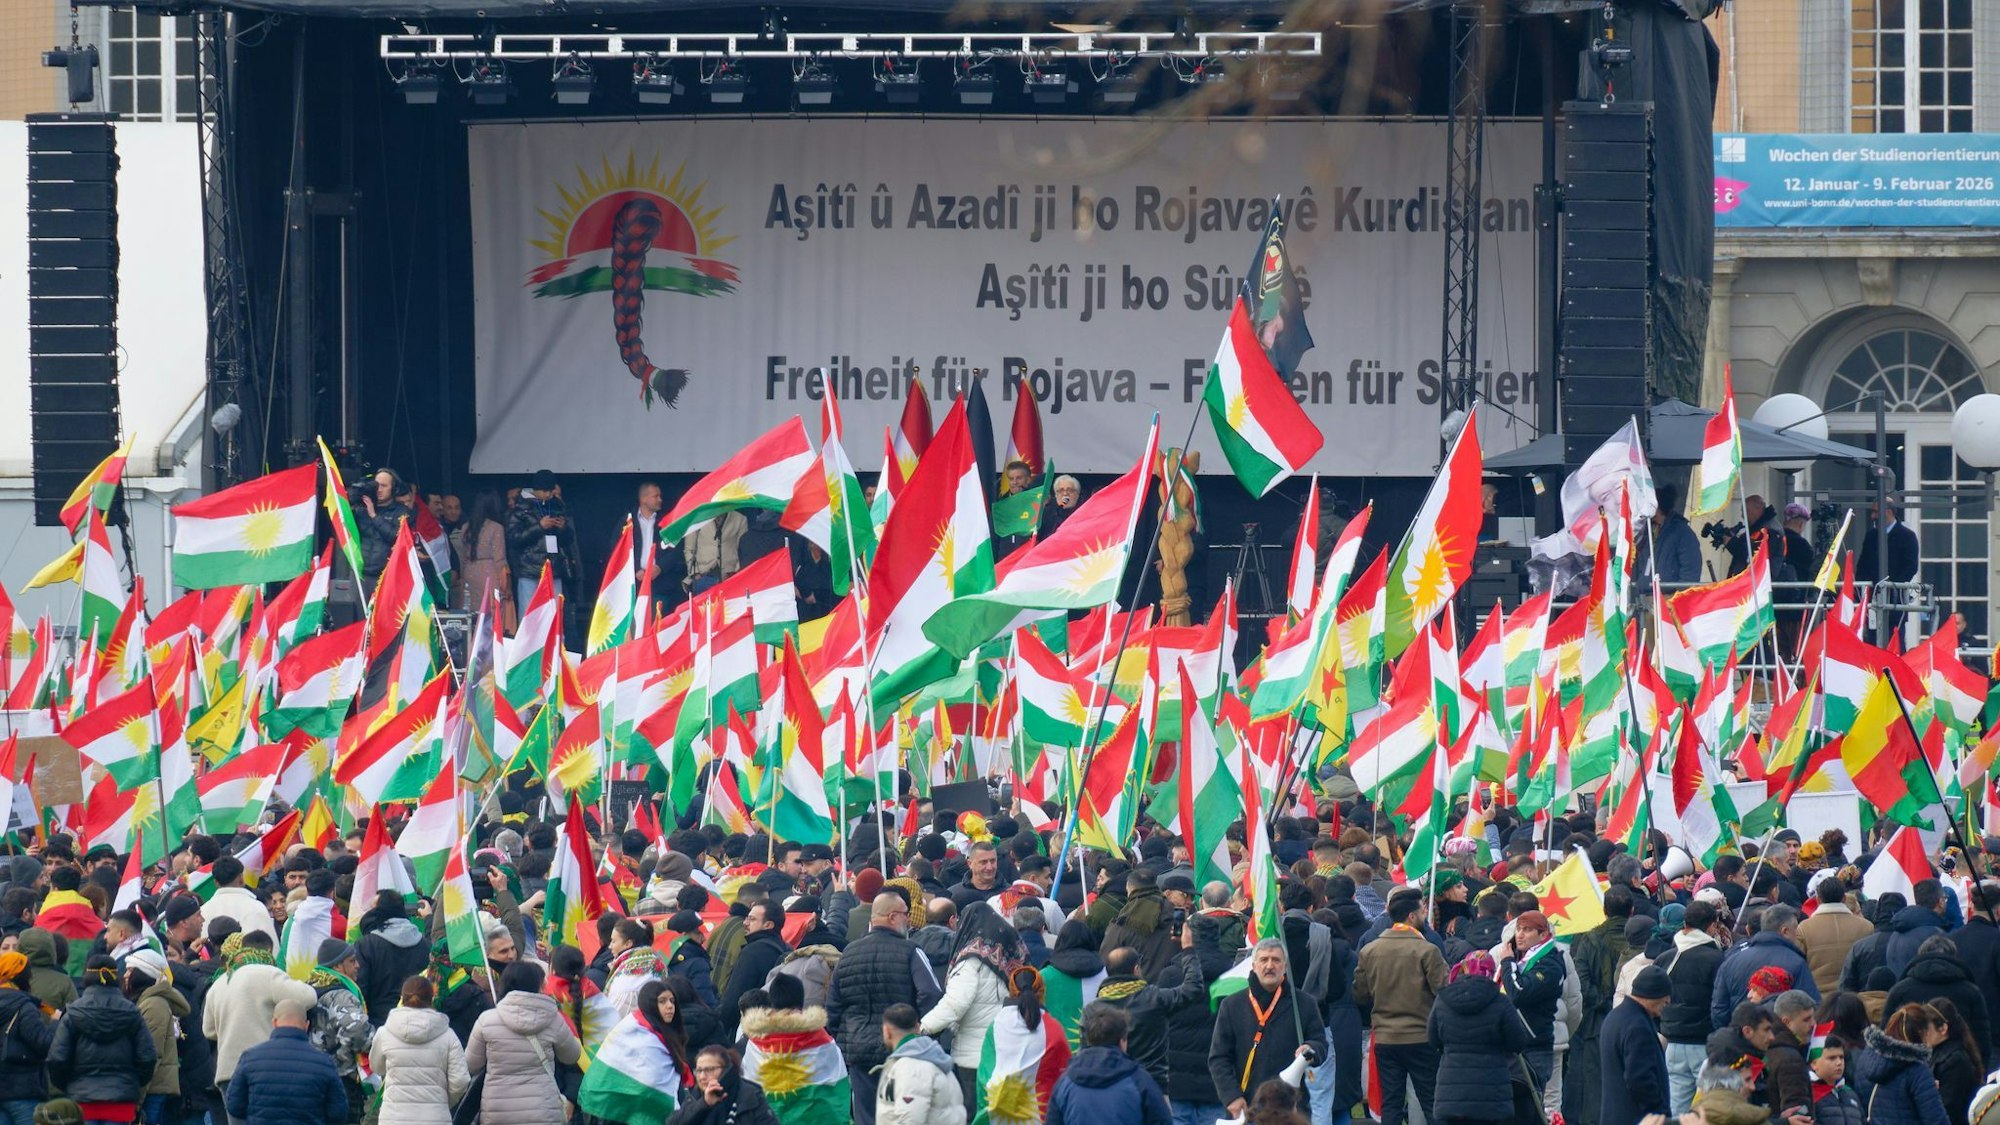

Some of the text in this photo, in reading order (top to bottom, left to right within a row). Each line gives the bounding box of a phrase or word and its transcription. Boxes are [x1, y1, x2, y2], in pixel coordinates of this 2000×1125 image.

[1769, 148, 2000, 162] Wochen der Studienorientierun
[765, 183, 857, 241] Aşîtî
[871, 183, 893, 230] û
[907, 183, 1021, 231] Azadî
[1030, 185, 1055, 242] ji
[1072, 185, 1119, 231] bo
[1784, 178, 1805, 191] 12.
[1808, 178, 1860, 191] Januar
[1873, 177, 1887, 190] 9.
[1891, 177, 1952, 190] Februar
[1955, 177, 1994, 190] 2026
[976, 263, 1071, 321] Aşîtî
[1080, 265, 1106, 322] ji
[1122, 265, 1169, 311] bo
[1003, 357, 1136, 414] Rojava
[1347, 359, 1404, 405] für
